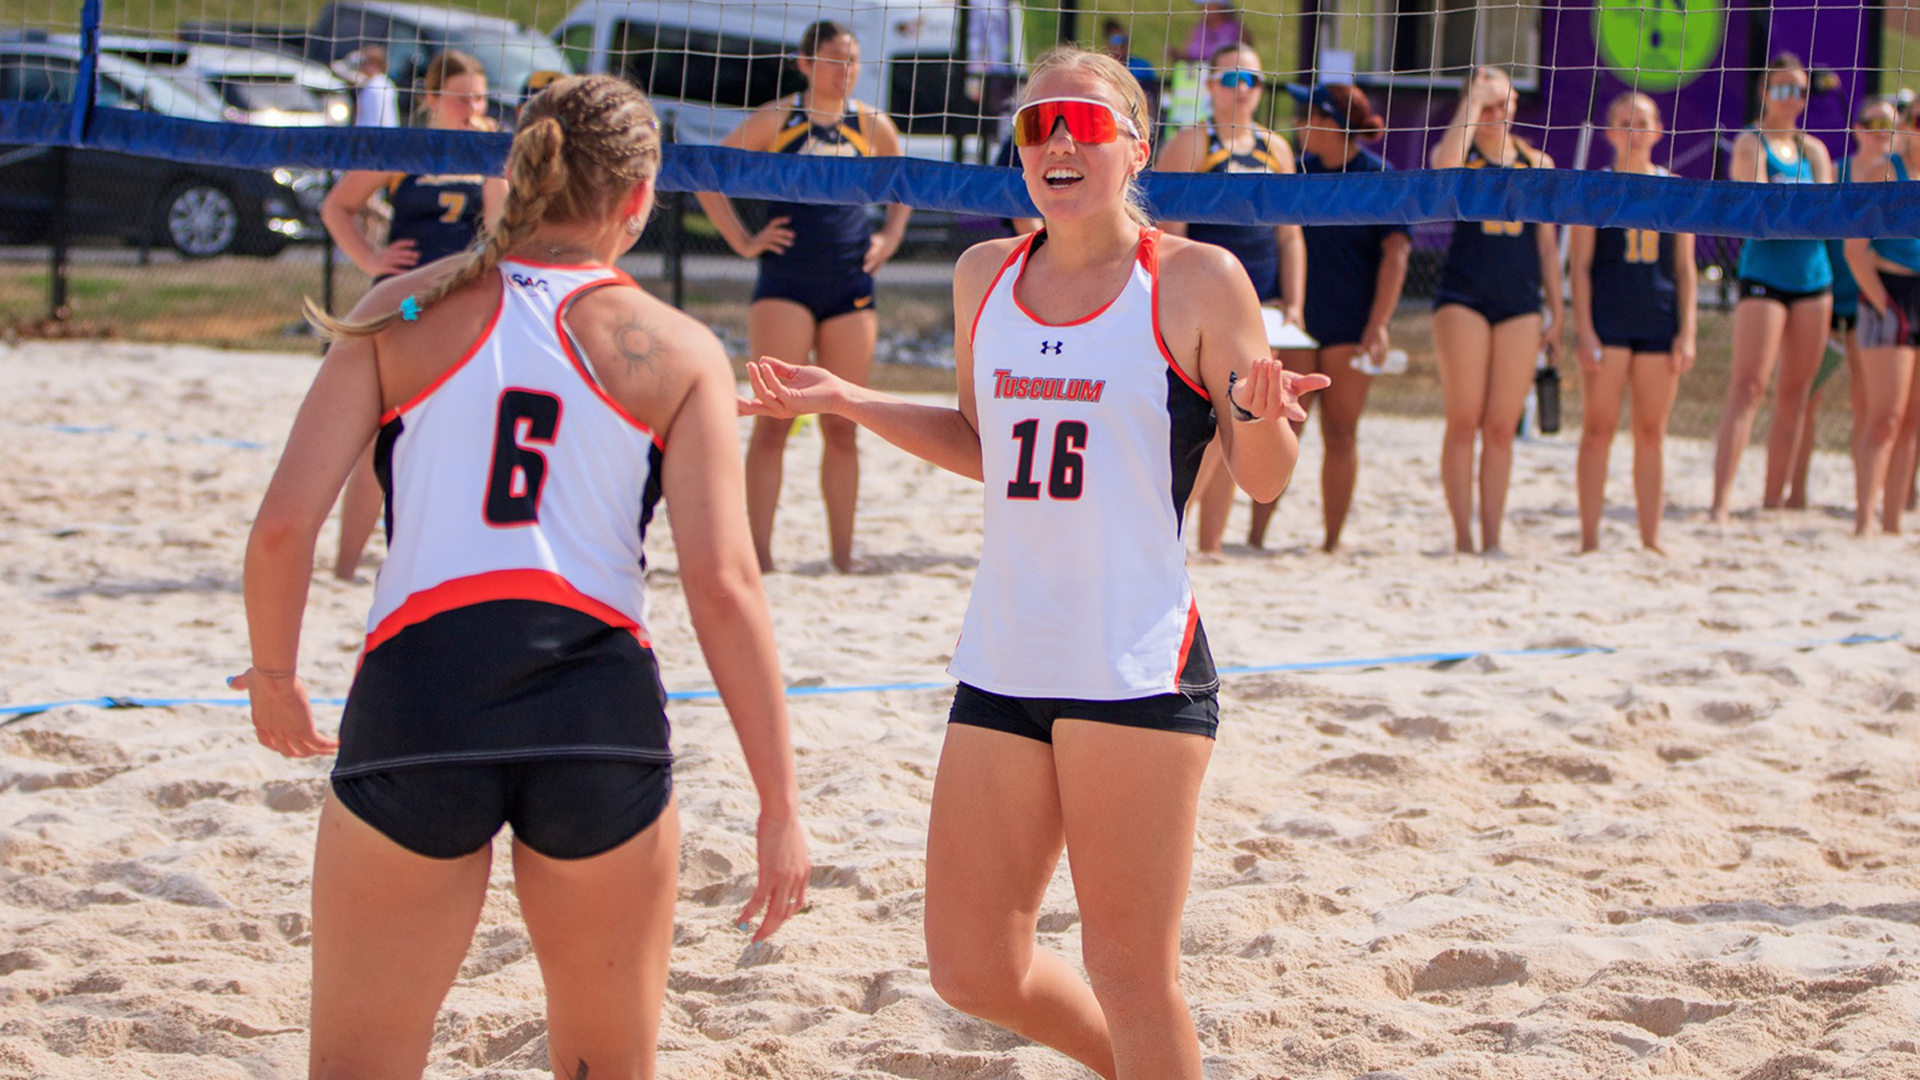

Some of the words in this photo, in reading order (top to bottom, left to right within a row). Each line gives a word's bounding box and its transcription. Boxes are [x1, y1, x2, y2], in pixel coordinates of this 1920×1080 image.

[439, 191, 467, 223] 7
[1625, 228, 1659, 264] 18
[482, 387, 563, 529] 6
[1006, 418, 1089, 501] 16
